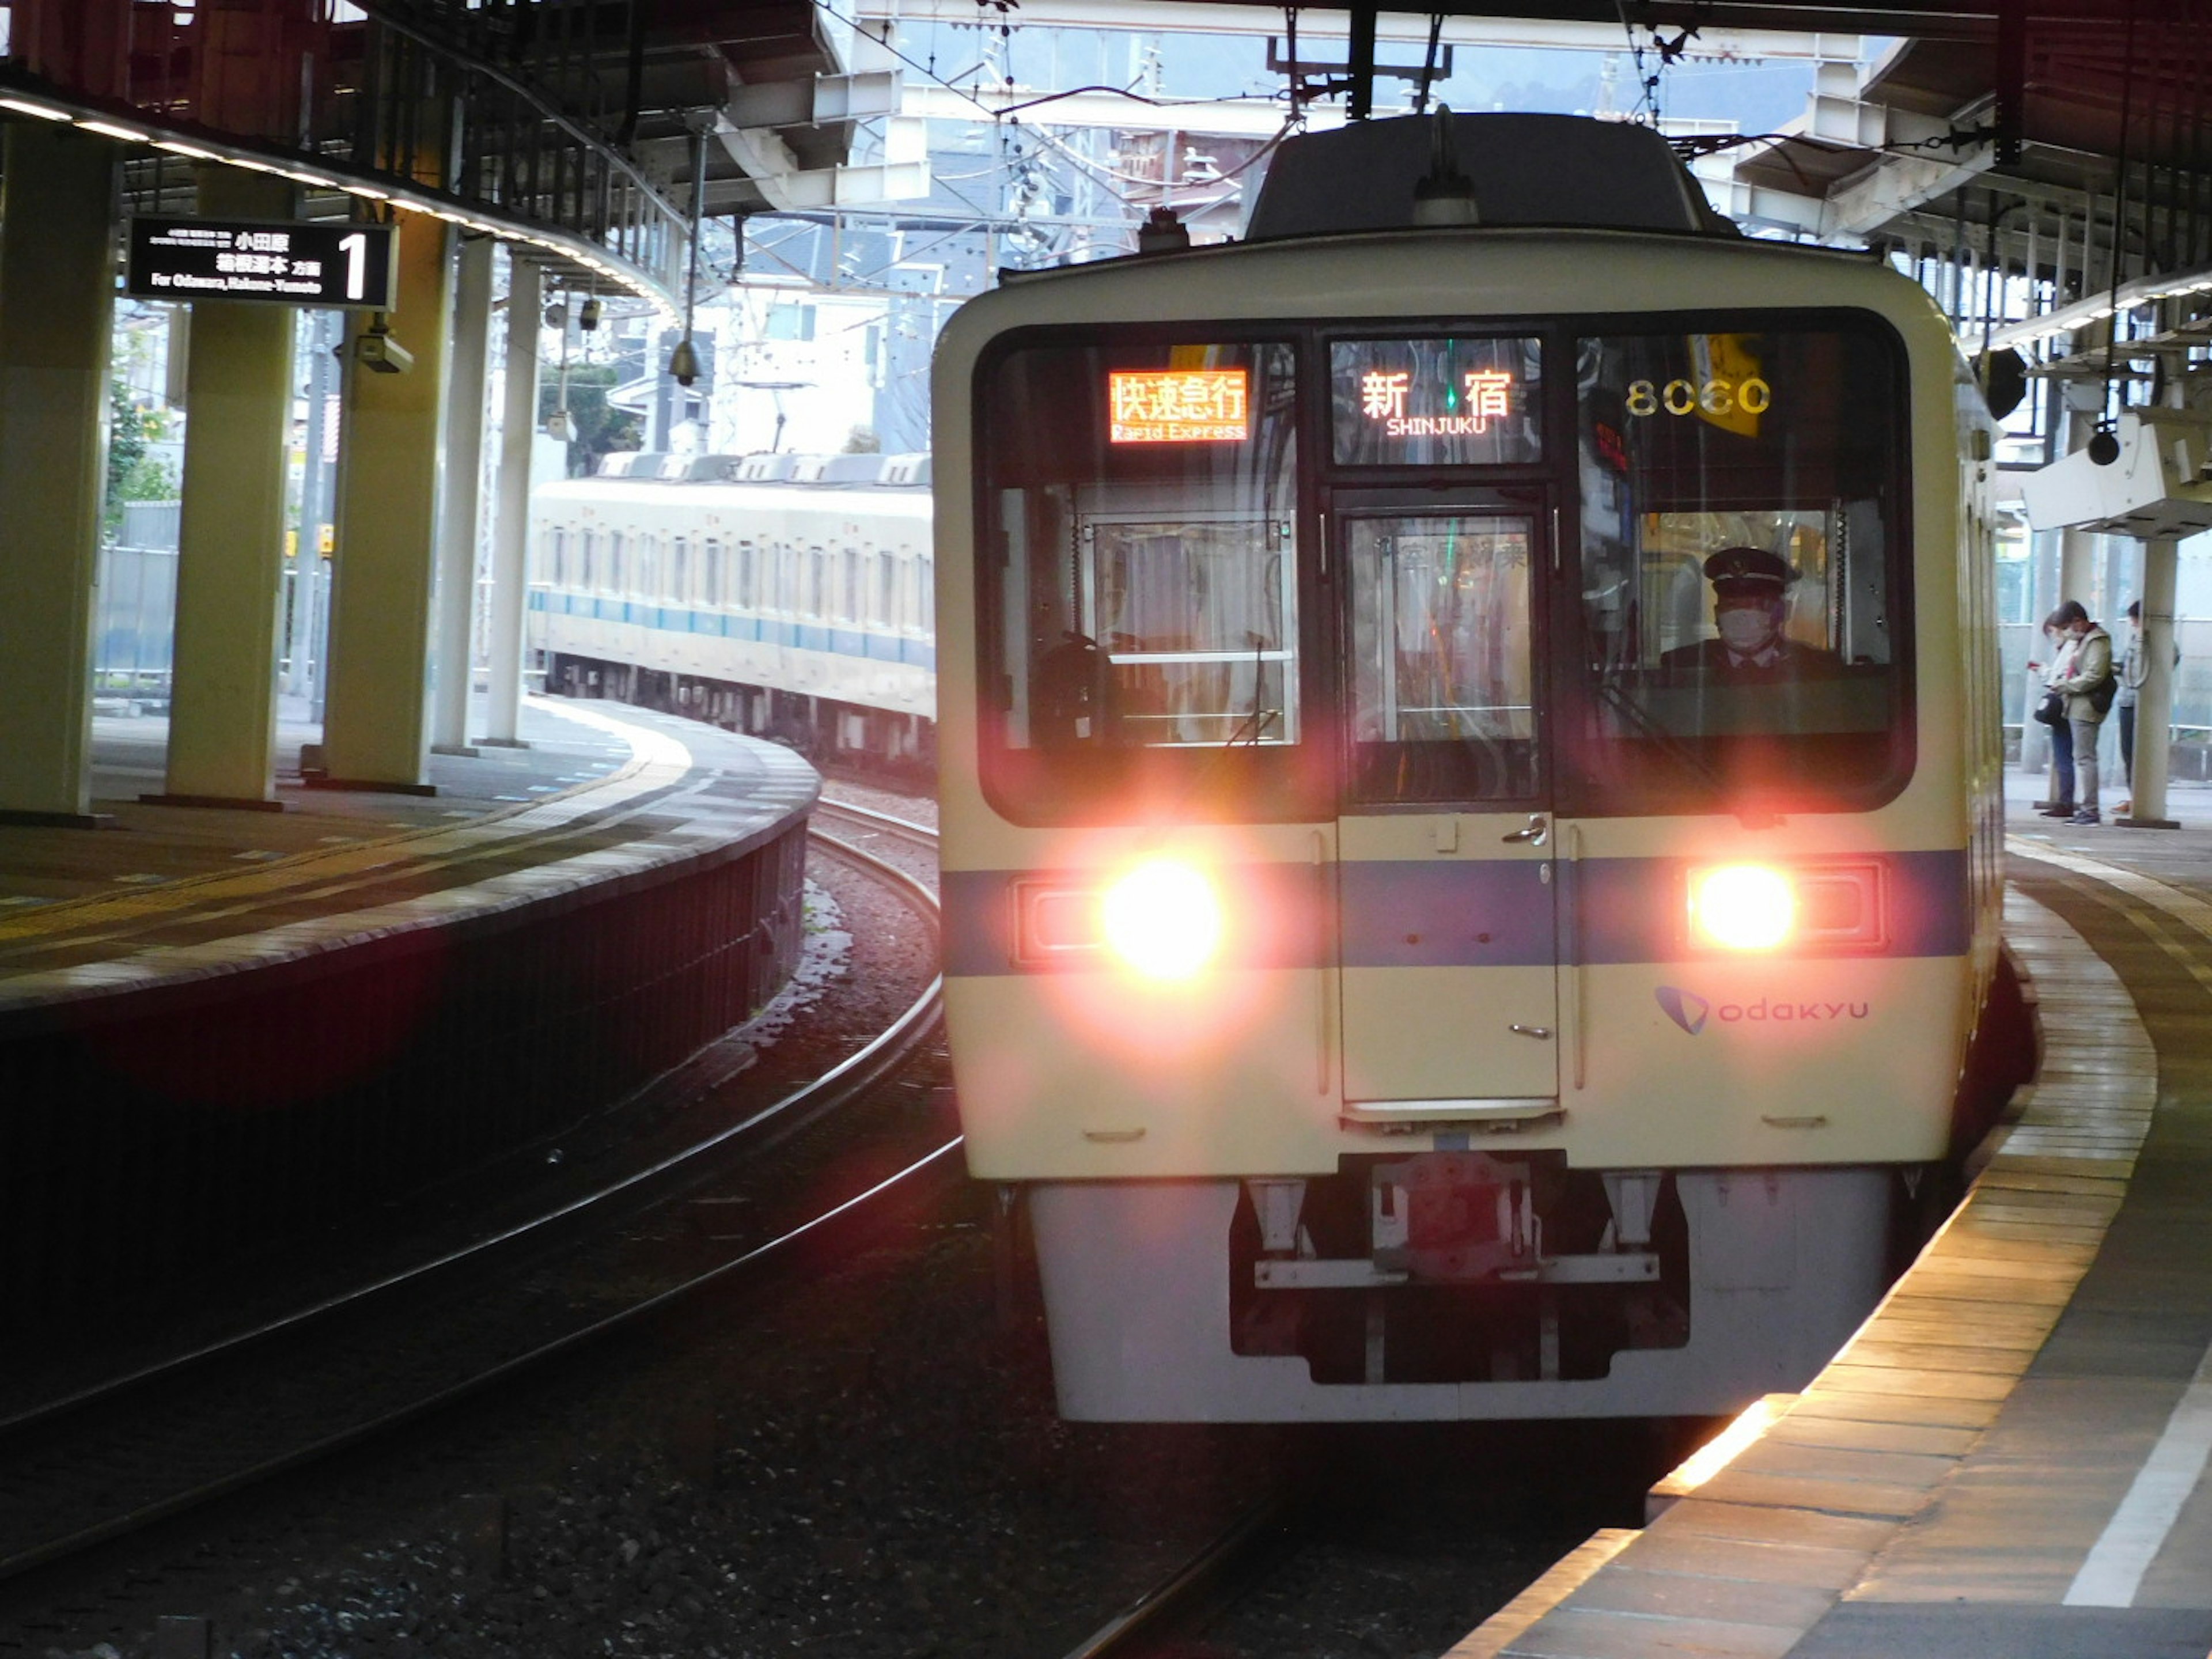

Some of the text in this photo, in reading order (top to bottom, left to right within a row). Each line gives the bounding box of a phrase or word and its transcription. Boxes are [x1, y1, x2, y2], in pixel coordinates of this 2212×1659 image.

[234, 232, 290, 252] 小田原
[291, 261, 322, 277] 方面
[339, 233, 366, 300] 1
[151, 272, 172, 287] For
[1112, 376, 1245, 421] 快速急行
[1626, 378, 1771, 416] 8060
[1112, 423, 1244, 440] Rapid Express
[1387, 417, 1486, 435] SHINJUKU
[1719, 998, 1869, 1022] odakyu
